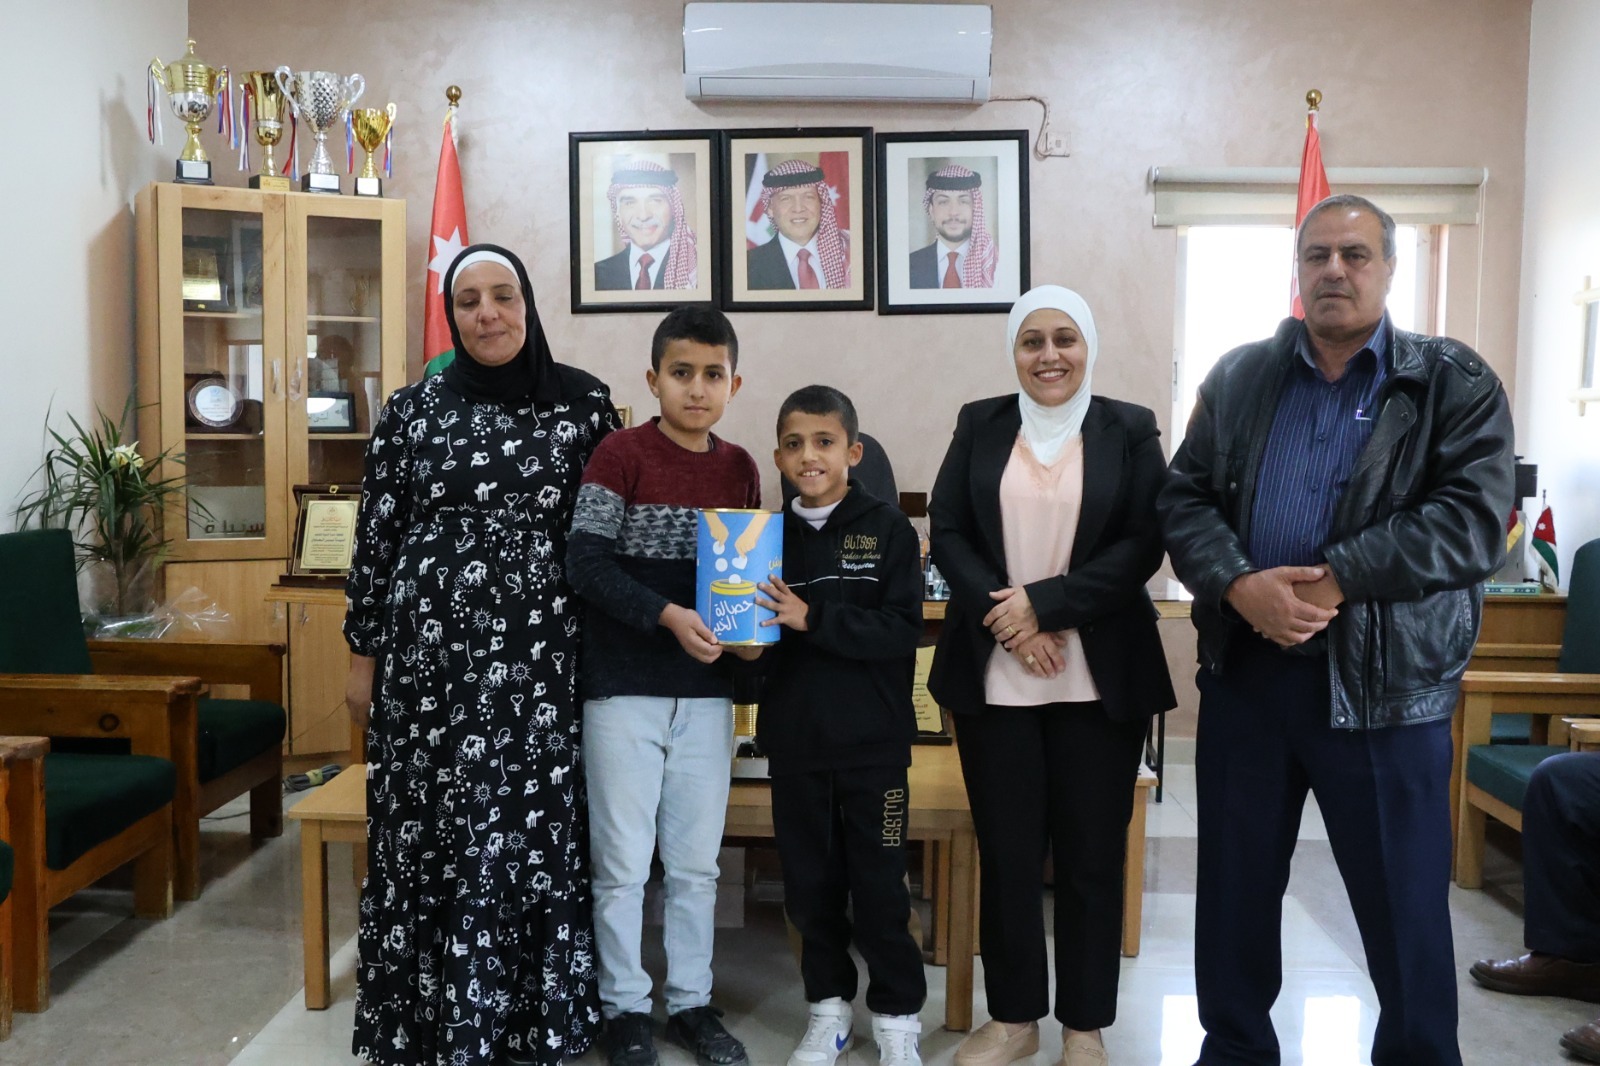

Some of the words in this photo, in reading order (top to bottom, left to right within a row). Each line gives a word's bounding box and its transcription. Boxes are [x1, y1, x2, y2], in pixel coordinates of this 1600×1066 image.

[843, 534, 878, 550] BLISSA
[714, 599, 754, 618] حصالة
[712, 614, 739, 637] الخير
[882, 788, 905, 847] BLISSA
